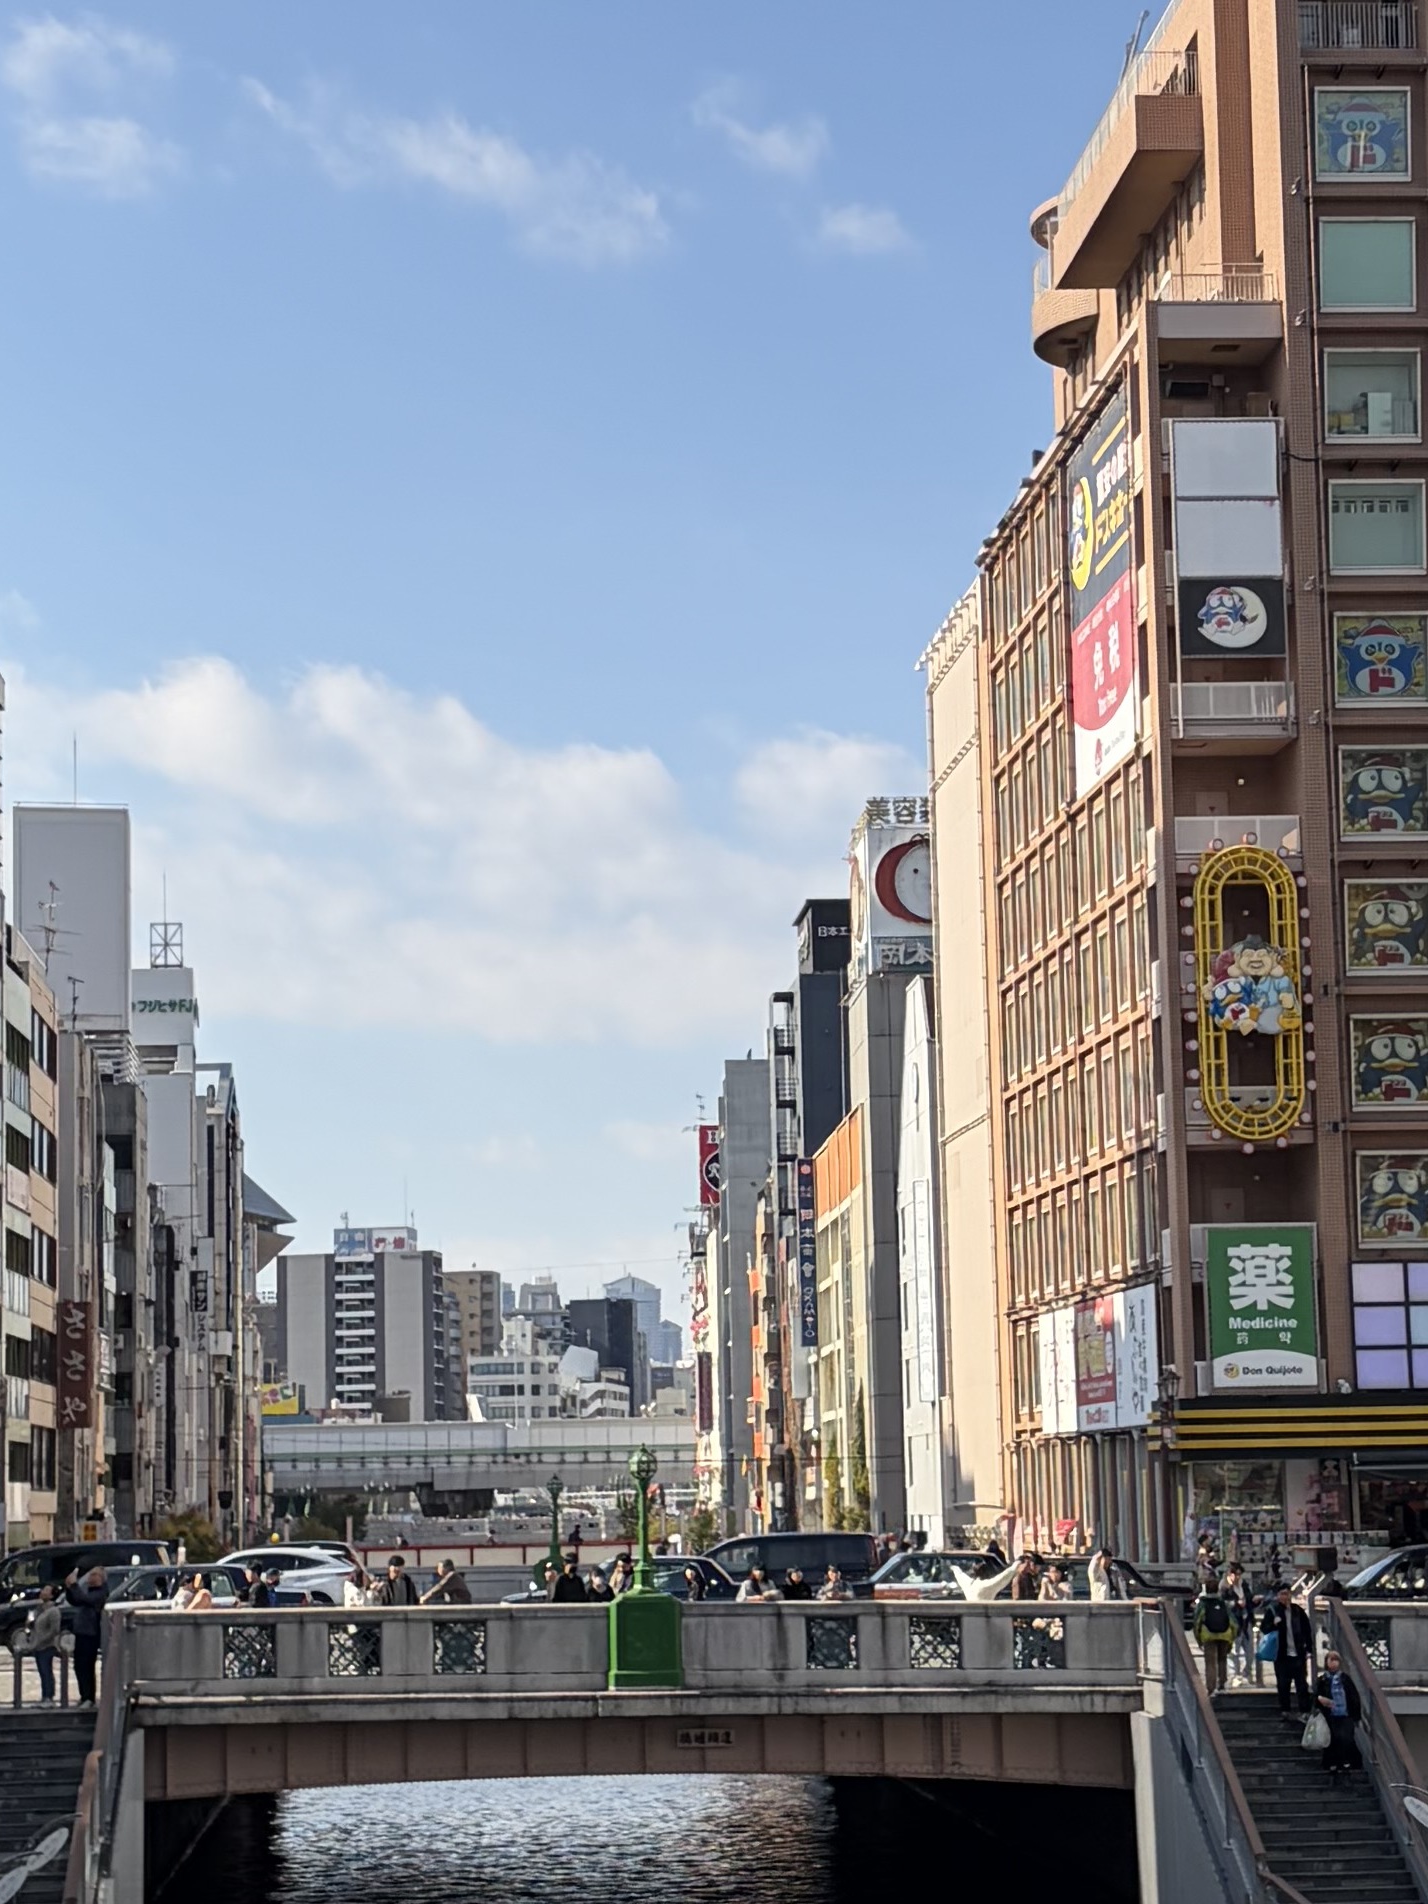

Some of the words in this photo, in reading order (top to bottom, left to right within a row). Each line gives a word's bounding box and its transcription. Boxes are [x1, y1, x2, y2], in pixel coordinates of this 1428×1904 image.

[1227, 1243, 1295, 1310] 薬
[1228, 1316, 1298, 1330] Medicine
[1242, 1366, 1263, 1375] Don
[1265, 1365, 1303, 1376] Quijote
